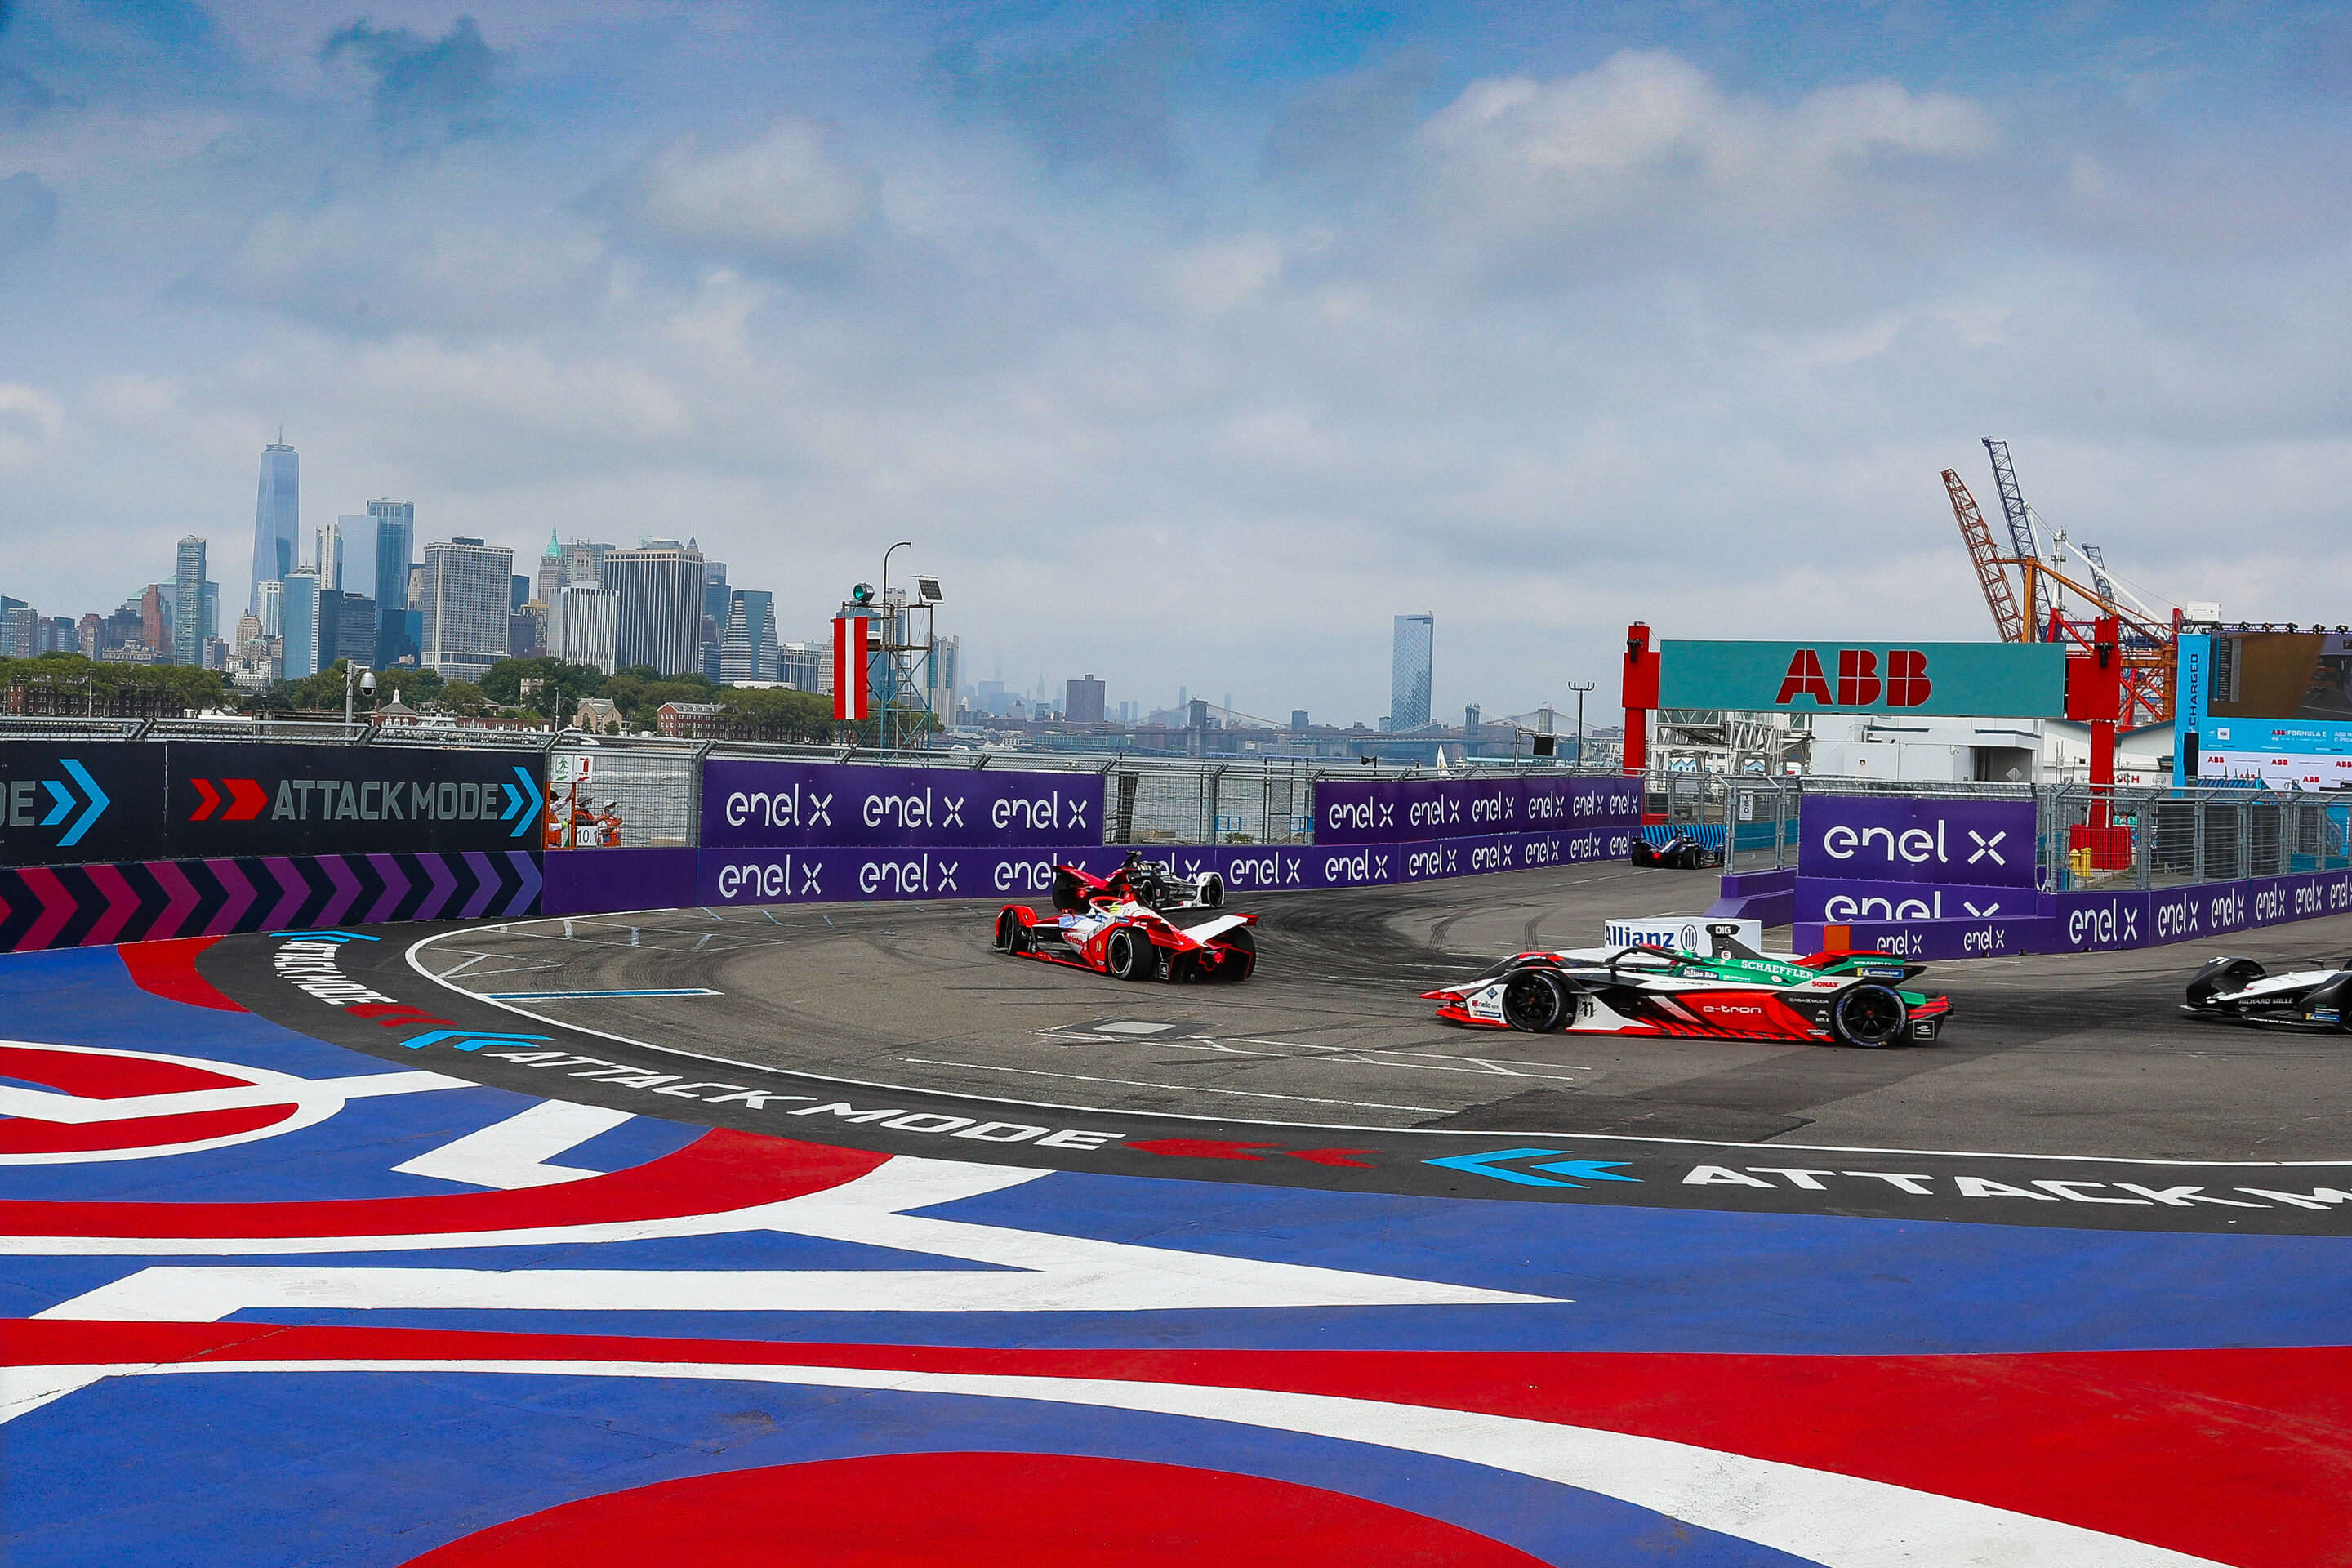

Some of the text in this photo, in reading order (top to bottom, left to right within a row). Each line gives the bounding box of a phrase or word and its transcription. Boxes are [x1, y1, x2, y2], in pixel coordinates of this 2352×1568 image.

[1775, 649, 1932, 706] ABB
[2189, 653, 2198, 725] CHARGED
[2115, 773, 2140, 784] SCH
[271, 780, 498, 820] ATTACK MODE
[726, 782, 800, 826] enel
[862, 787, 933, 828] enel
[992, 791, 1058, 829] enel
[1328, 796, 1374, 830] enel
[1410, 794, 1445, 826] enel
[1472, 791, 1502, 822] enel
[1528, 791, 1553, 819] enel
[1573, 790, 1595, 817] enel
[1610, 790, 1630, 815] enel
[1472, 840, 1501, 870] enel
[1526, 835, 1550, 864] enel
[1570, 832, 1592, 863] enel
[1610, 831, 1630, 856] enel
[1824, 819, 1949, 863] enel
[719, 854, 791, 898] enel
[859, 853, 929, 893] enel
[1230, 852, 1280, 885] enel
[1325, 849, 1370, 882] enel
[1409, 844, 1442, 877] enel
[2211, 887, 2235, 929] enel
[2256, 882, 2278, 920] enel
[2296, 878, 2315, 915] enel
[2330, 875, 2348, 909] enel
[1715, 925, 1731, 934] DIG
[2069, 898, 2118, 944] enel
[2158, 893, 2186, 938] enel
[1605, 925, 1675, 948] Allianz
[1877, 929, 1908, 955] enel
[1963, 925, 1992, 951] enel
[1683, 968, 1704, 978] Julius
[1740, 960, 1815, 979] SCHAEFFLER
[1811, 980, 1839, 988] SONAX
[284, 975, 399, 1005] MODE
[1582, 1001, 1594, 1018] 11
[1703, 1004, 1762, 1014] e-tron
[482, 1051, 1126, 1151] ATTACK MODE
[1682, 1165, 2274, 1209] ATTACK
